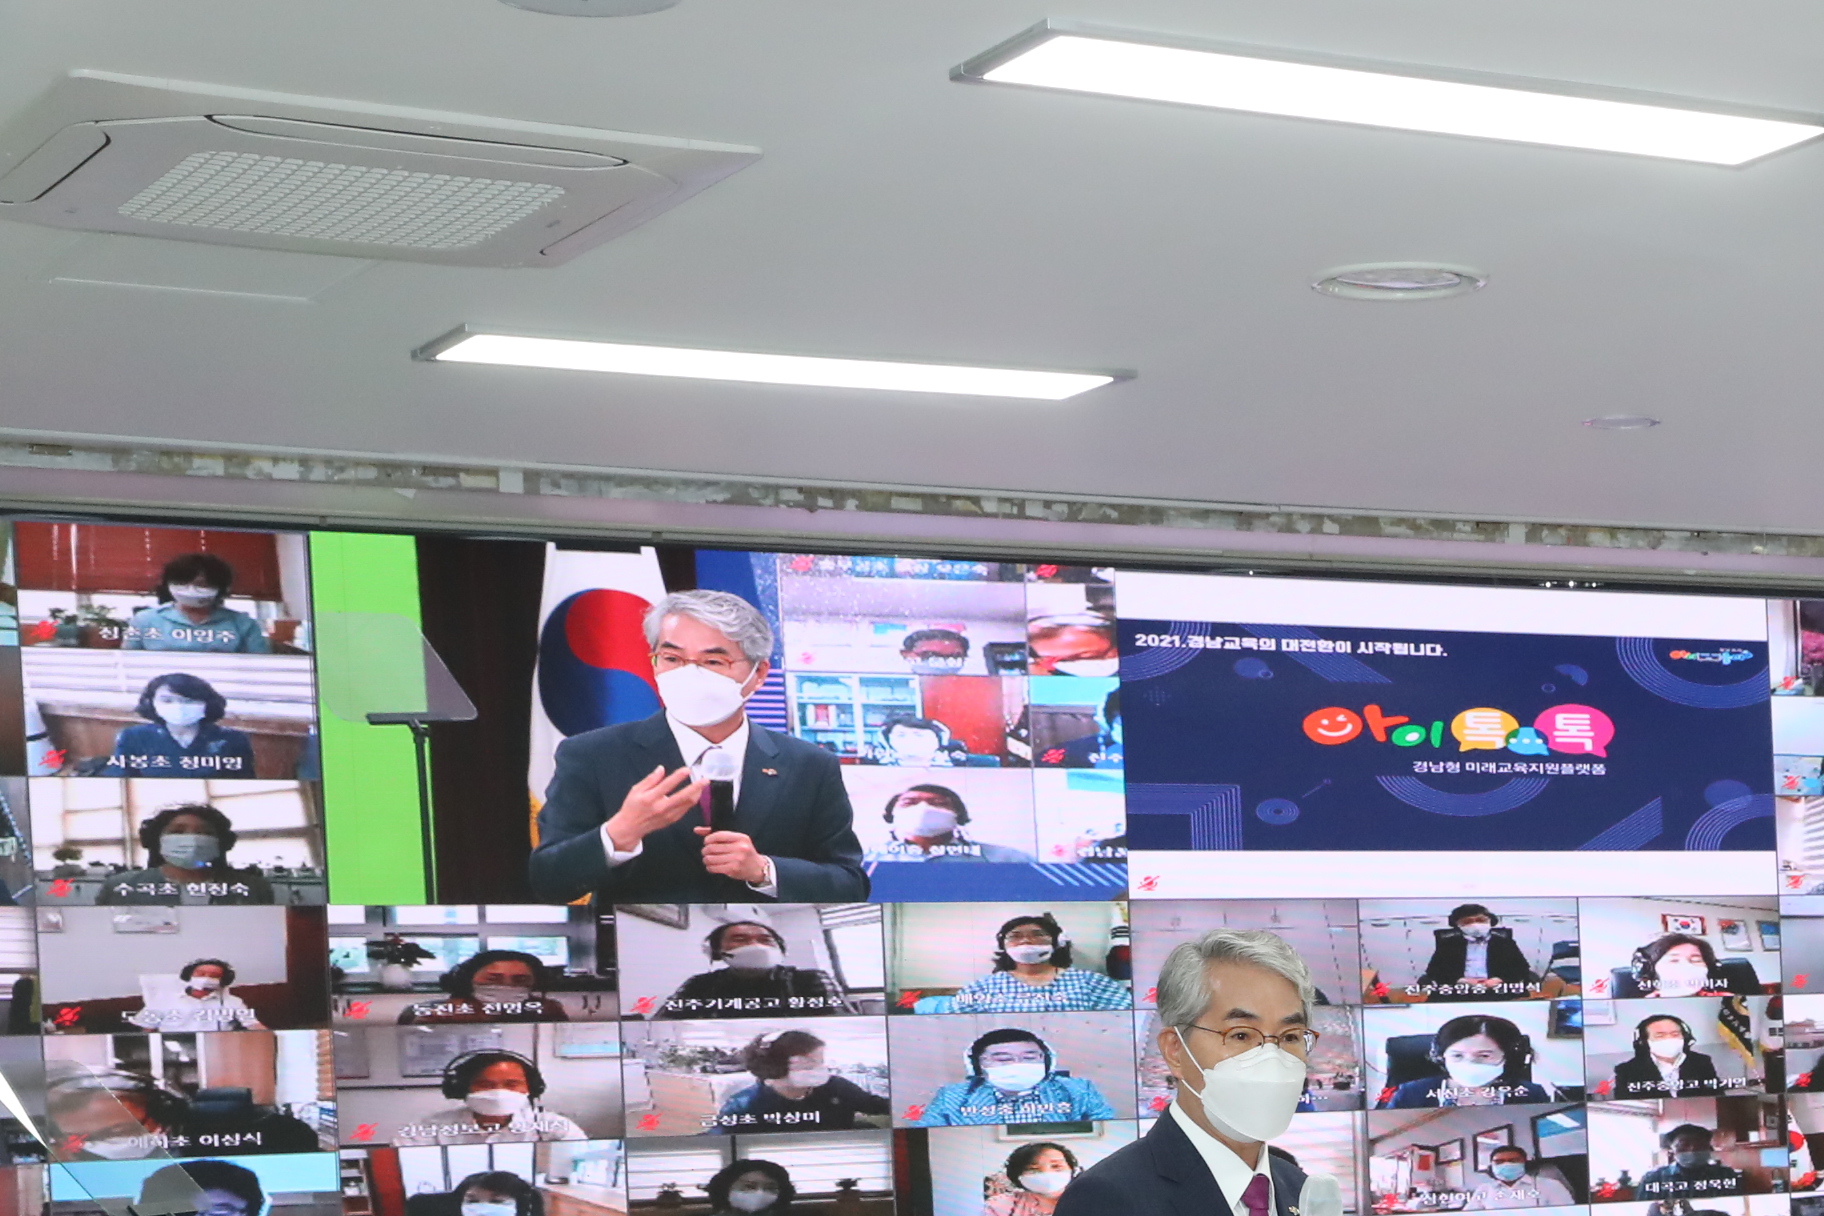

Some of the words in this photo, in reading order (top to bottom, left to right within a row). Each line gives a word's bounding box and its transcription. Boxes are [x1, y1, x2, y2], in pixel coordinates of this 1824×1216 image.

[1134, 634, 1277, 652] 2021.경남교육의
[1281, 639, 1351, 654] 대전환이
[1357, 641, 1448, 657] 시작됩니다.
[1412, 760, 1461, 774] 경남형
[1465, 761, 1607, 776] 미래교육지원플랫폼
